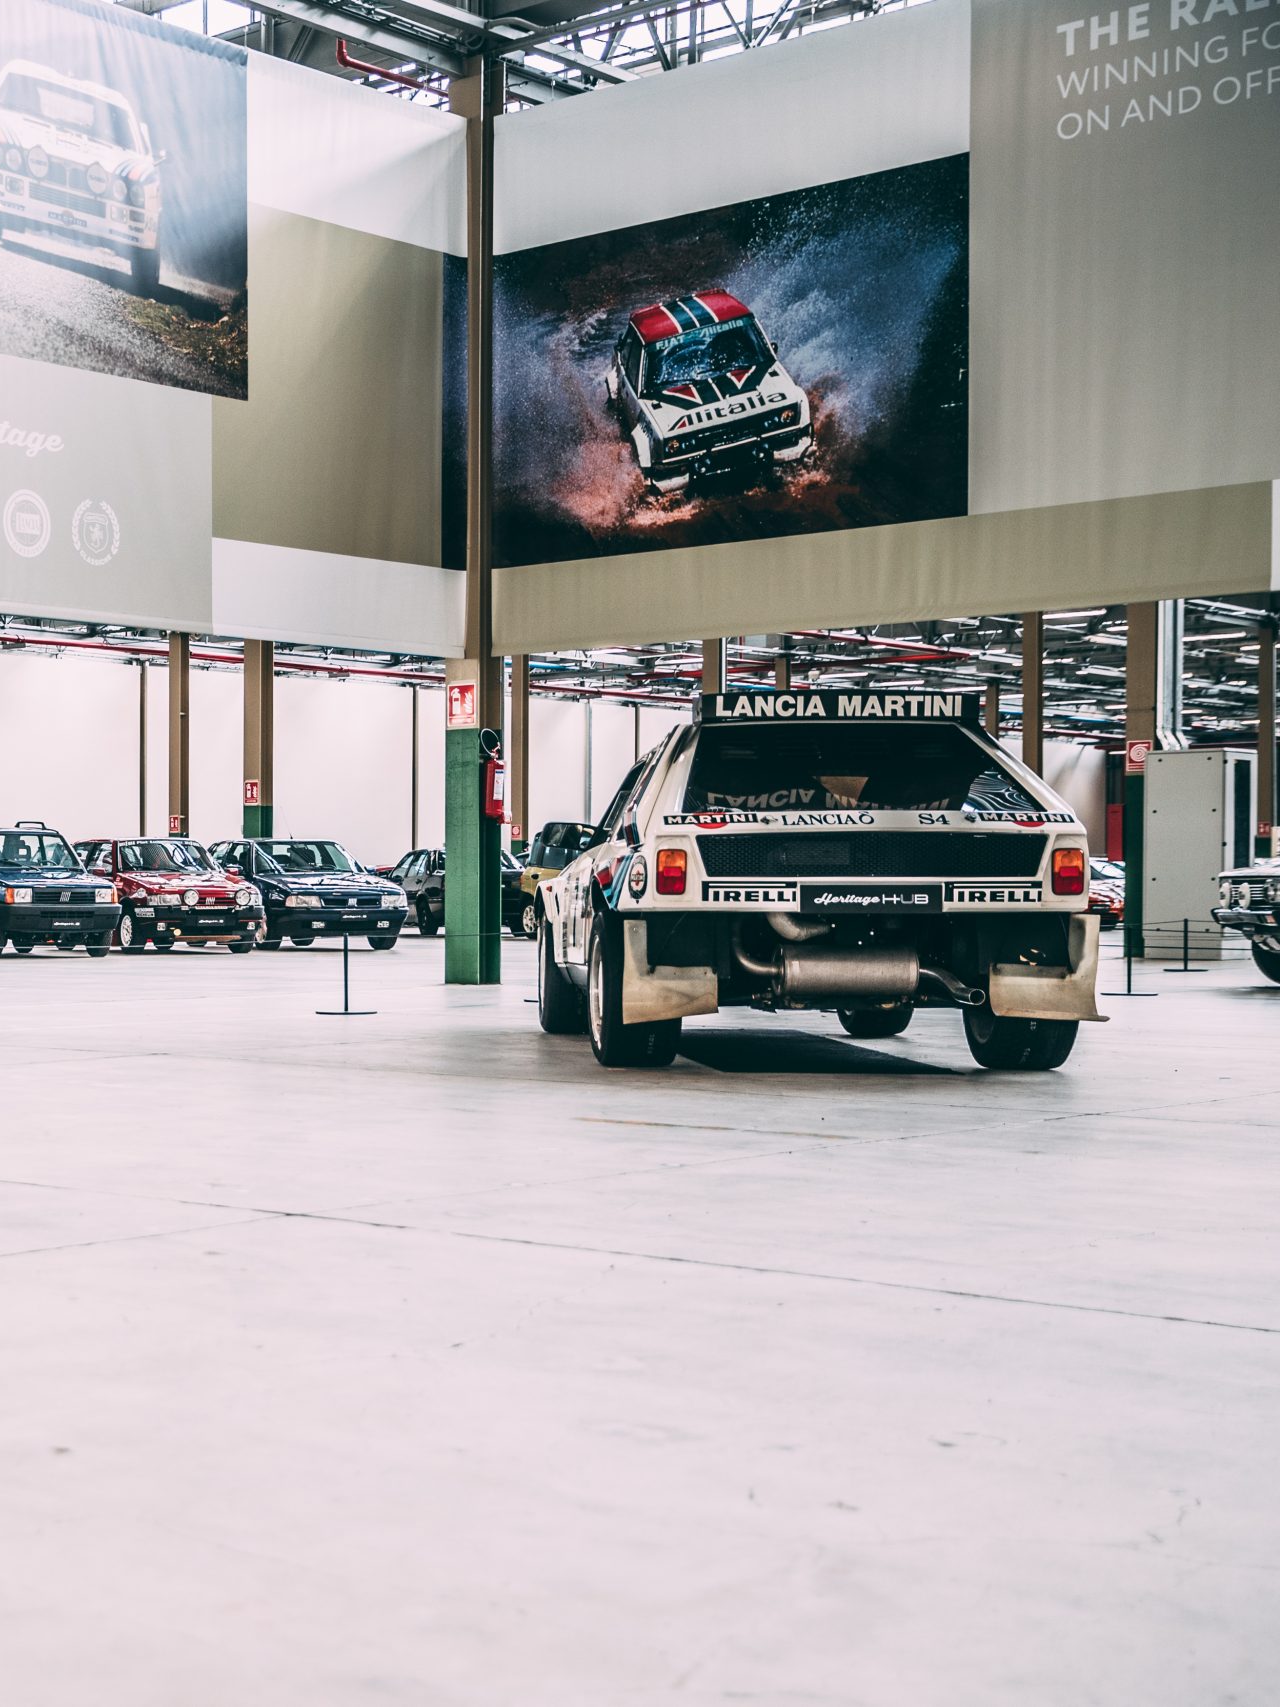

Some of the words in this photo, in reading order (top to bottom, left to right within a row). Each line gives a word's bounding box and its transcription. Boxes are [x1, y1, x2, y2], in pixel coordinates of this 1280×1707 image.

[1056, 3, 1150, 57] THE
[1056, 35, 1229, 98] WINNING
[1057, 104, 1110, 140] ON
[1120, 86, 1201, 128] AND
[655, 335, 686, 351] FIAT
[667, 391, 788, 432] Alitalia
[715, 695, 827, 718] LANCIA
[837, 695, 962, 718] MARTINI
[667, 813, 756, 825] MARTINI
[918, 813, 950, 825] S4
[983, 813, 1071, 823] MARTINI
[701, 881, 797, 902] PIRELLI
[814, 892, 880, 906] Heritage
[882, 894, 929, 904] HUB
[944, 881, 1042, 902] PIRELLI
